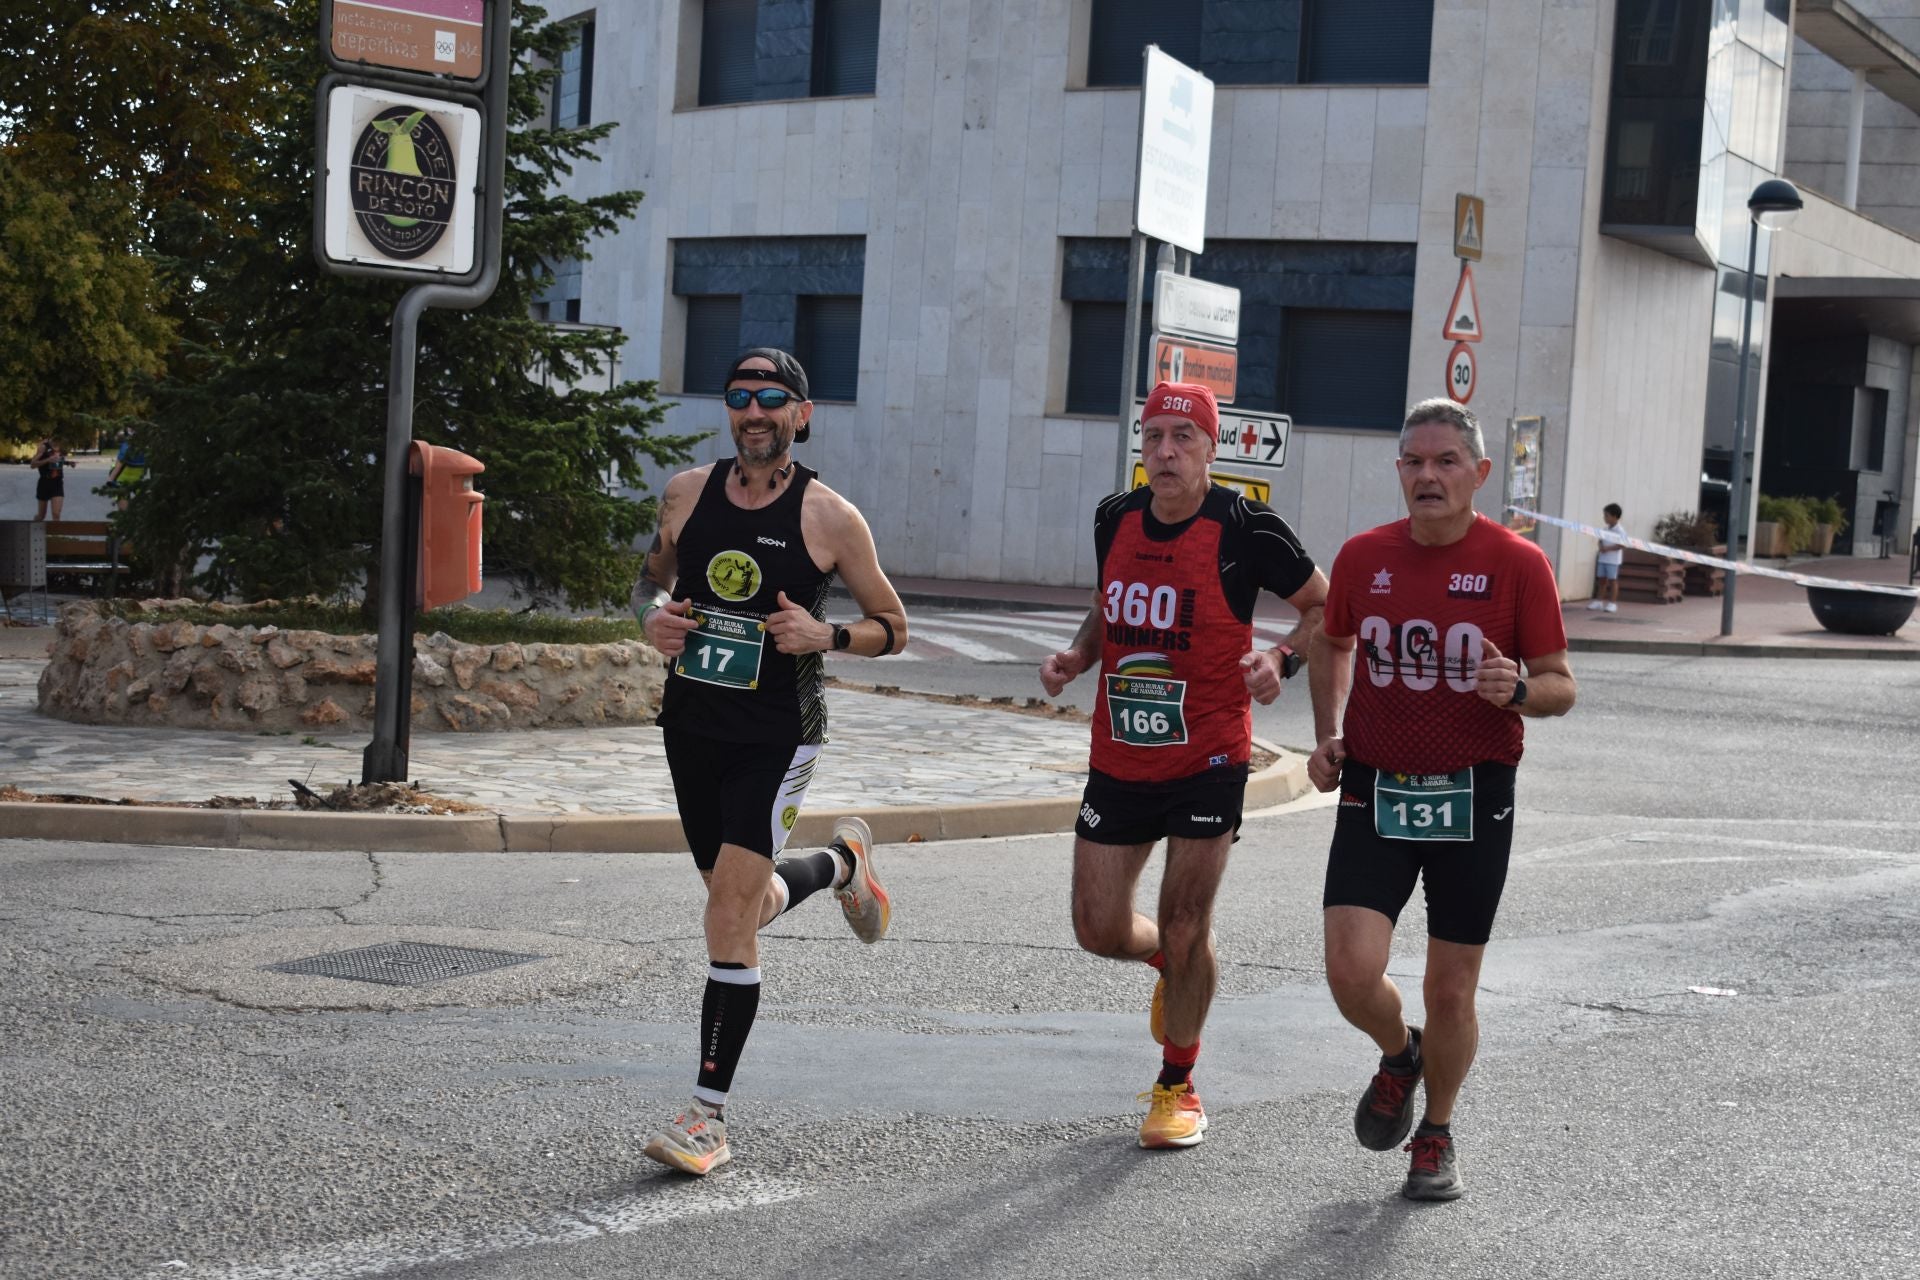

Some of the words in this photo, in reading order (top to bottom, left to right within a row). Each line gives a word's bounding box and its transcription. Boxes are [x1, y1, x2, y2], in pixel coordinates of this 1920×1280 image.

[358, 172, 449, 204] RINCÓN
[369, 195, 390, 211] DE
[394, 200, 436, 217] SOTO
[1213, 303, 1236, 326] urbano
[1454, 364, 1470, 386] 30
[1162, 395, 1193, 413] 360
[1448, 573, 1488, 593] 360
[1104, 580, 1177, 630] 360
[717, 625, 747, 636] NAVARRA
[725, 620, 745, 629] RURAL
[1106, 623, 1192, 651] RUNNERS
[697, 644, 735, 673] 17
[1140, 688, 1168, 697] NAVARRA
[1145, 683, 1166, 691] RURAL
[1119, 708, 1170, 734] 166
[1080, 802, 1102, 829] 360
[1191, 814, 1214, 823] luanvi
[1392, 801, 1453, 828] 131
